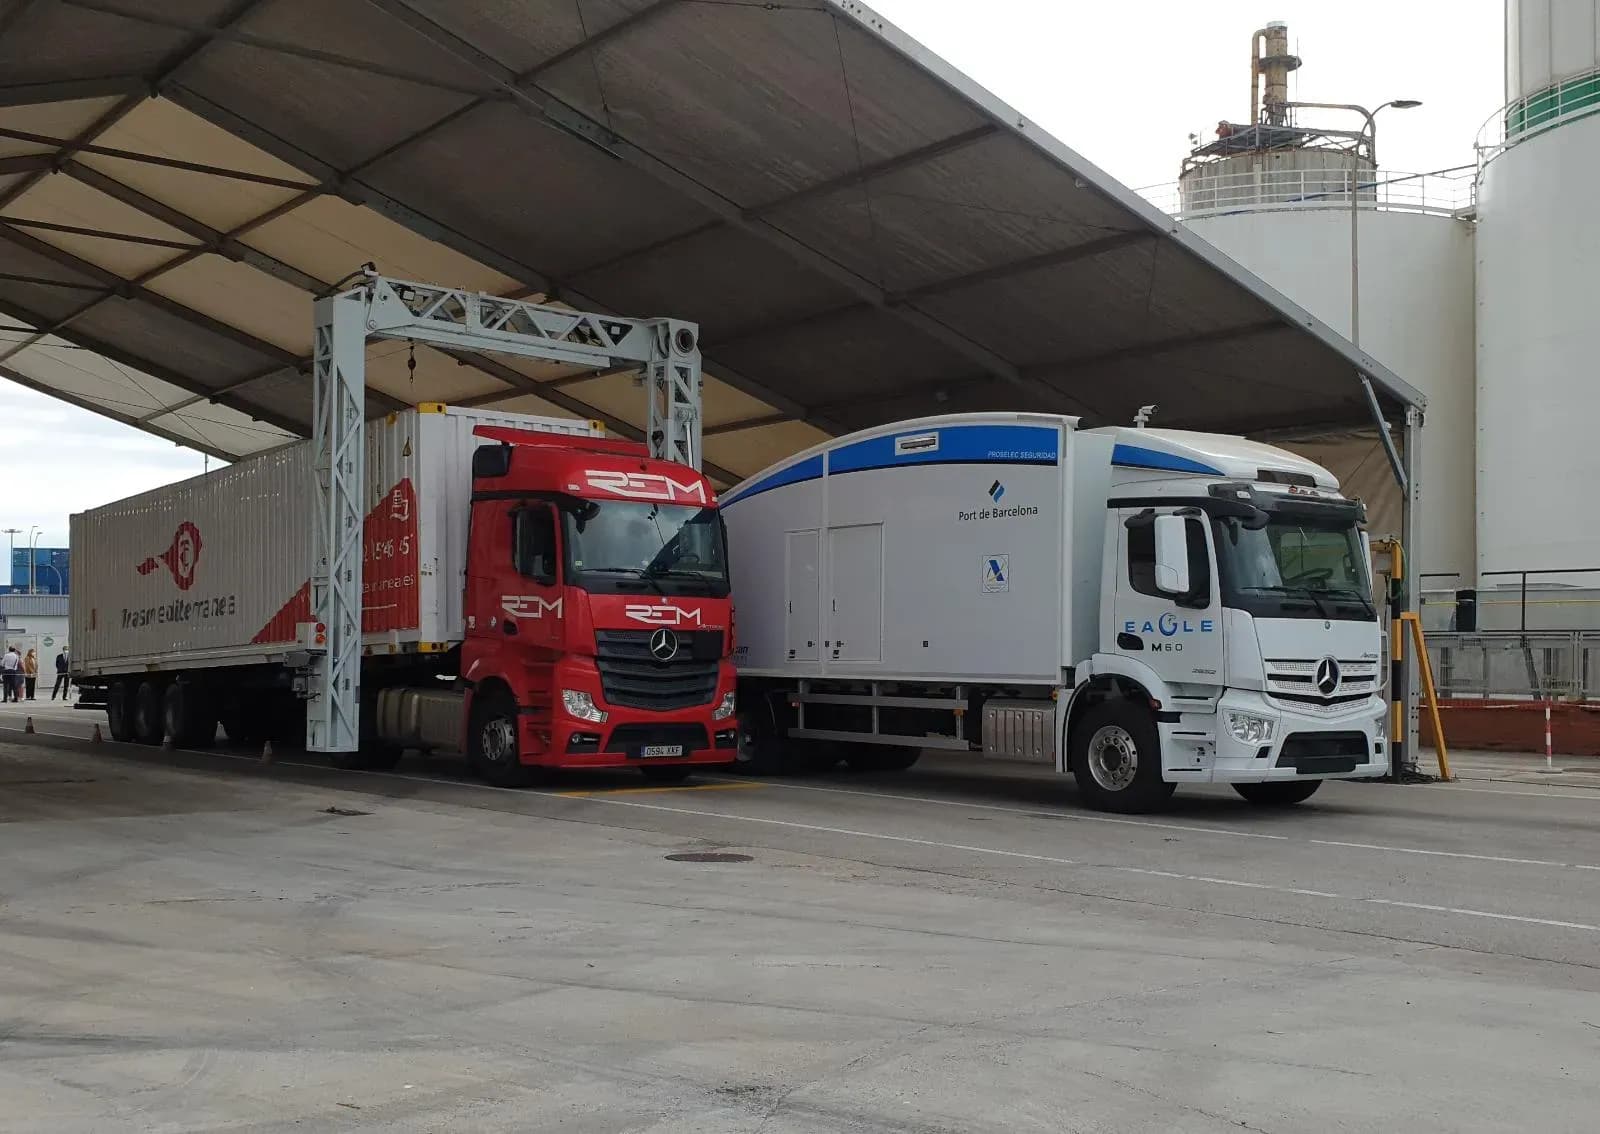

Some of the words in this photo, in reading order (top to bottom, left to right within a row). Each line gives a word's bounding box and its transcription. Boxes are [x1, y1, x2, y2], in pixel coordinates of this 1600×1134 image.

[987, 451, 1019, 459] PROSELEC
[1020, 451, 1056, 459] SEGURIDAD
[584, 469, 707, 504] REM
[959, 511, 977, 521] Port
[979, 508, 990, 519] de
[993, 504, 1038, 519] Barcelona
[502, 595, 562, 619] REM
[625, 604, 701, 625] REM
[1124, 612, 1213, 636] EAGLE
[1151, 643, 1183, 652] M60
